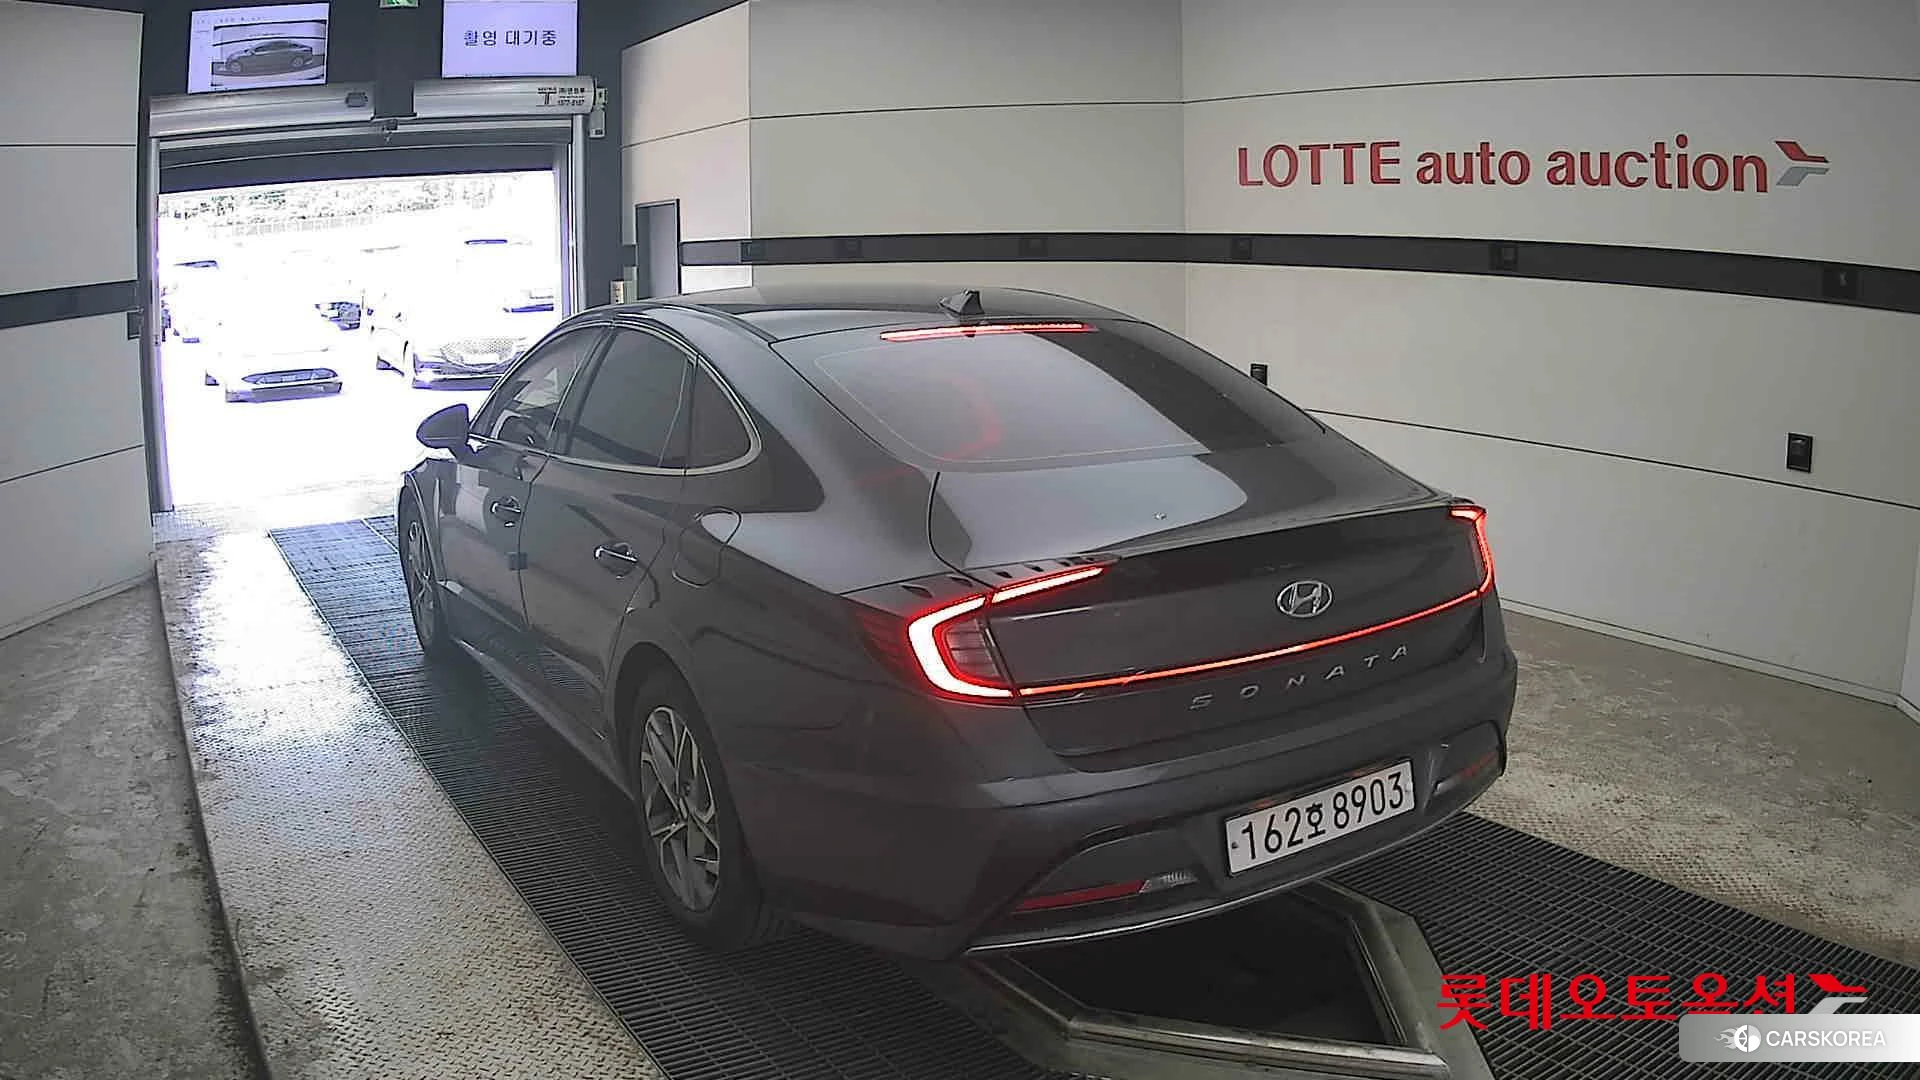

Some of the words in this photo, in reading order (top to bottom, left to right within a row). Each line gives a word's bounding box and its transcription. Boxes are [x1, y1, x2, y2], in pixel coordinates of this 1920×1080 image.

[505, 29, 557, 46] 대기중
[1238, 141, 1400, 187] LOTTE
[1416, 141, 1530, 185] auto
[1546, 133, 1768, 193] auction
[1189, 645, 1408, 711] SONATA
[1241, 803, 1326, 860] 162호
[1333, 771, 1405, 831] 8903
